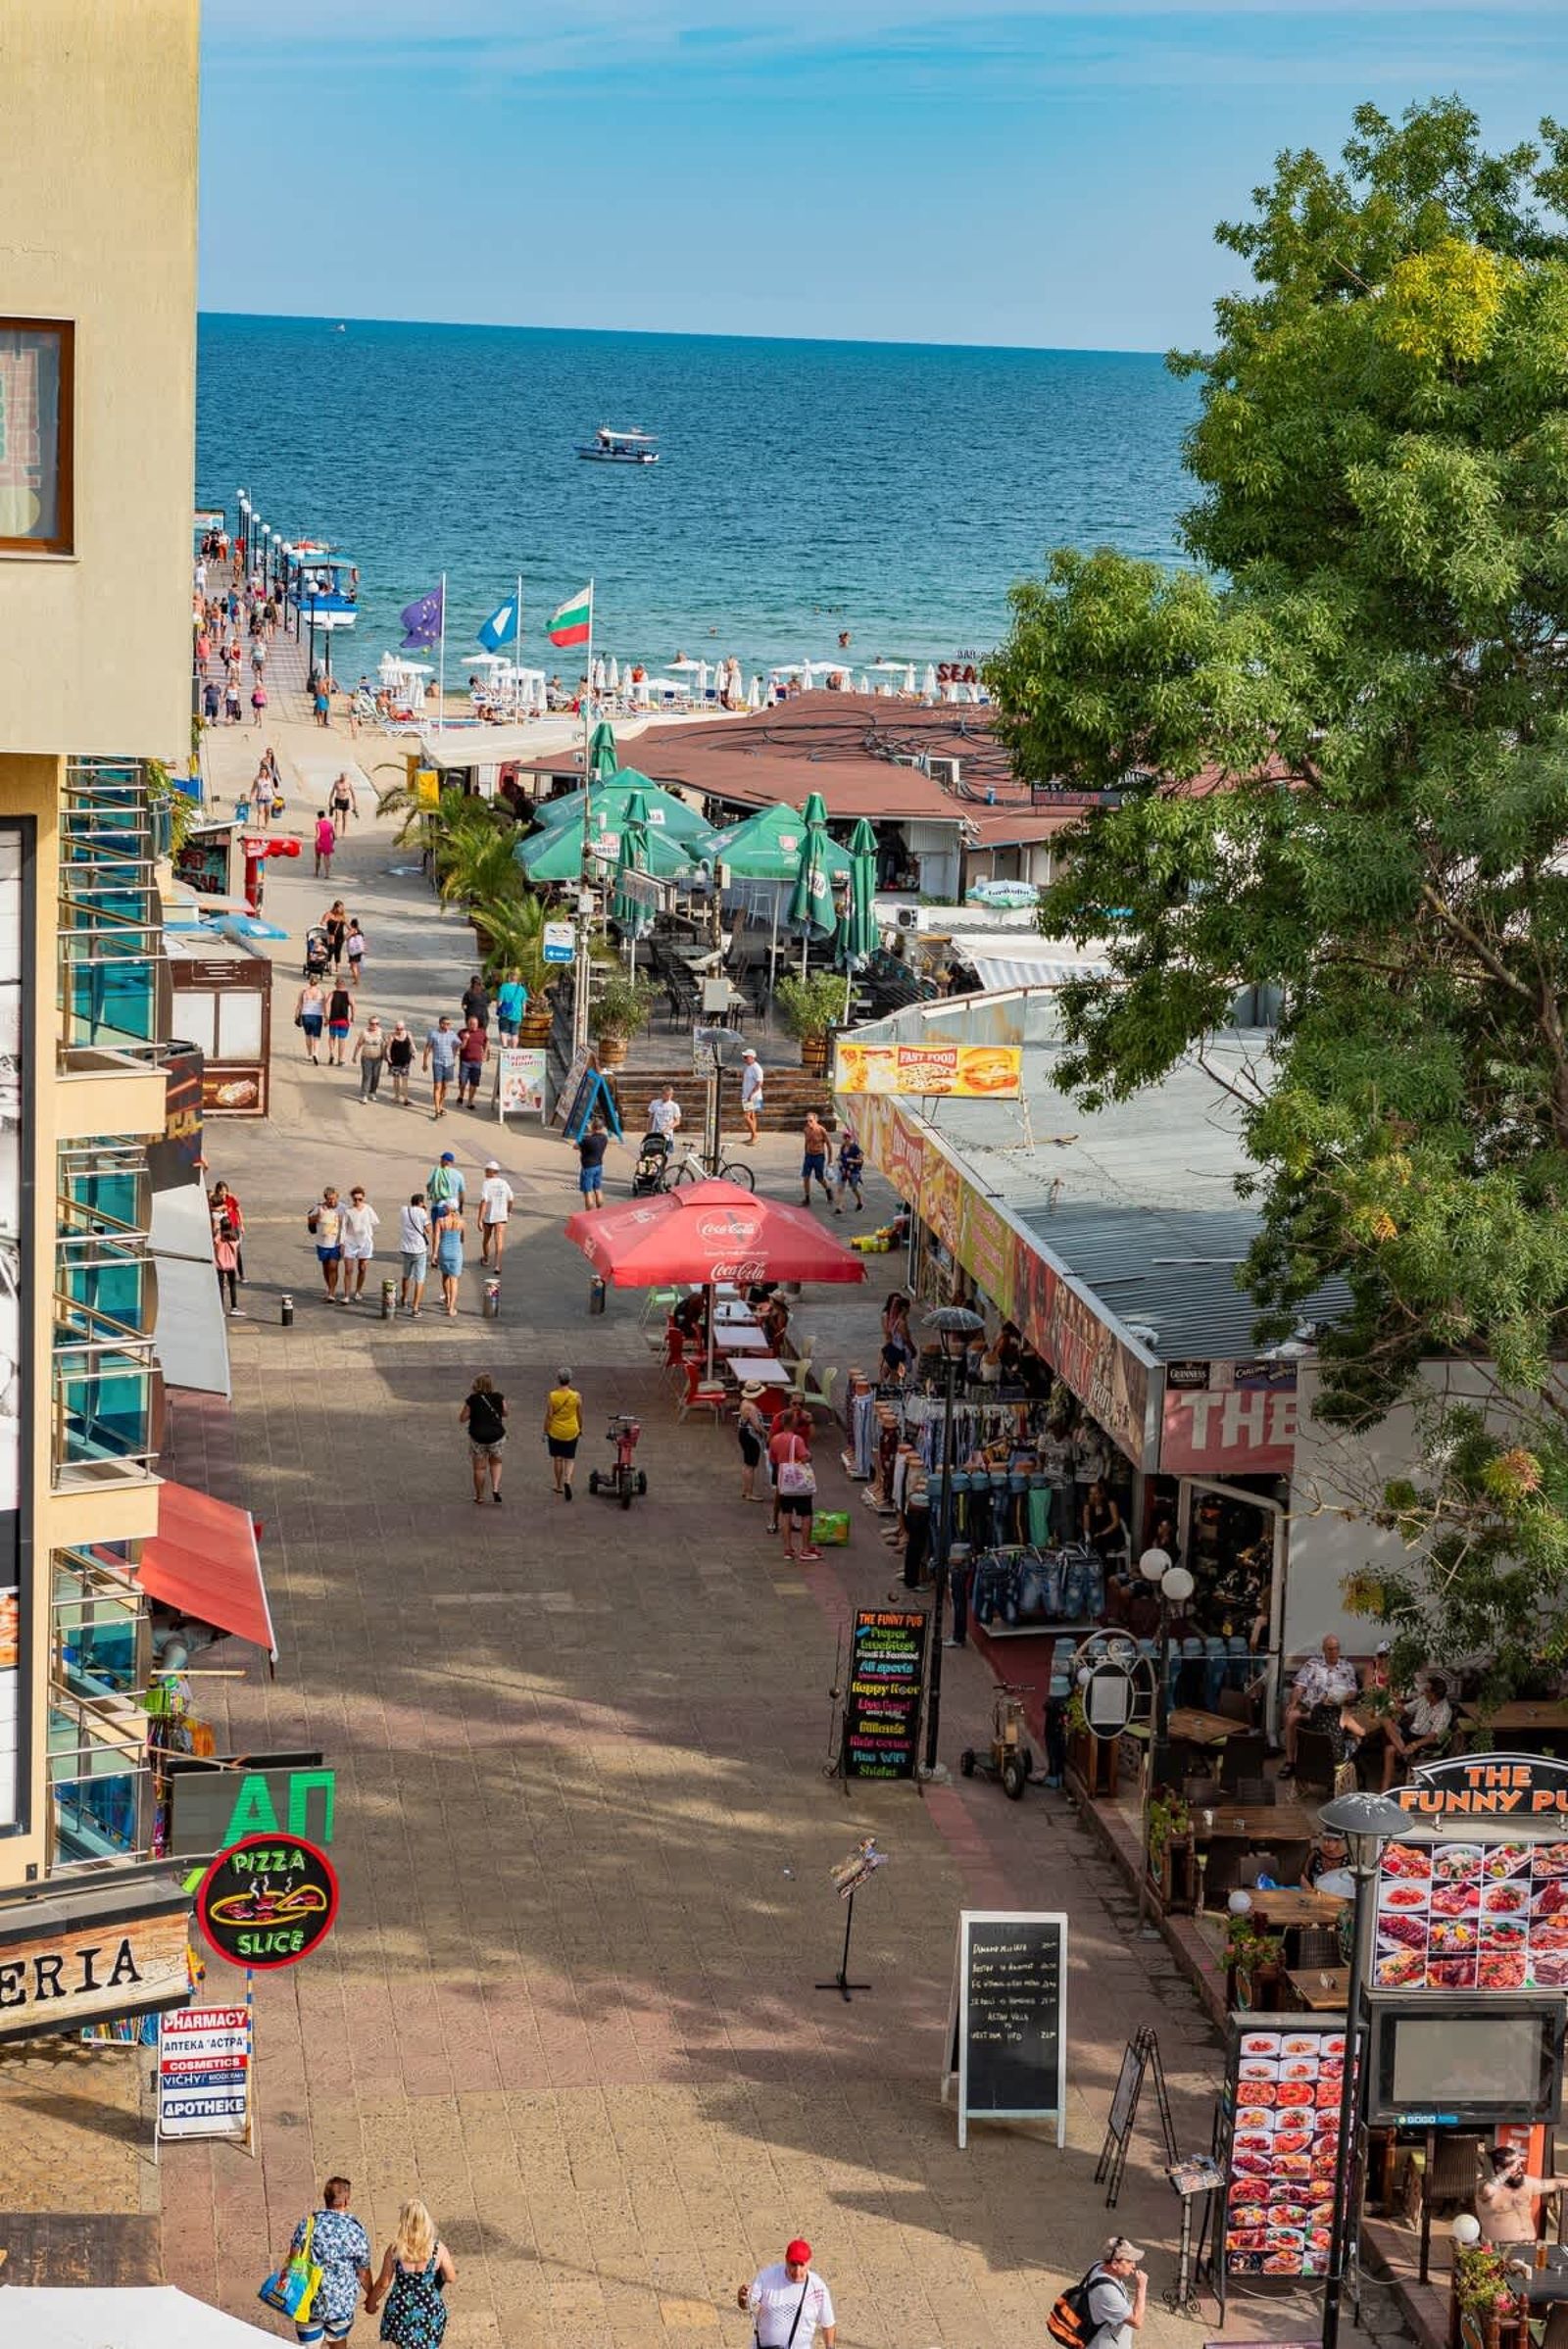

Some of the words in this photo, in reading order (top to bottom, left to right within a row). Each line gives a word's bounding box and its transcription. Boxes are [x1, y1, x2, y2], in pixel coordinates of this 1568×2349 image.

[936, 662, 976, 684] SEA
[900, 1051, 924, 1063] FAST
[927, 1052, 956, 1064] FOOD
[702, 1222, 757, 1236] Coca-Cola
[710, 1260, 766, 1281] Coca-Cola
[1169, 1368, 1207, 1381] GUINNESS
[1180, 1391, 1298, 1450] THE
[858, 1613, 876, 1626] THE
[877, 1614, 905, 1628] FUNNY
[1464, 1765, 1533, 1787] THE
[1398, 1788, 1524, 1813] FUNNY
[231, 1848, 306, 1874] PIZZA
[236, 1931, 305, 1955] SLICE
[164, 2012, 246, 2031] PHARMACY
[164, 2039, 204, 2051] АПТЕКА
[169, 2057, 241, 2072] COSMETICS
[164, 2074, 202, 2085] VICHY
[164, 2098, 245, 2117] APOTHEKE
